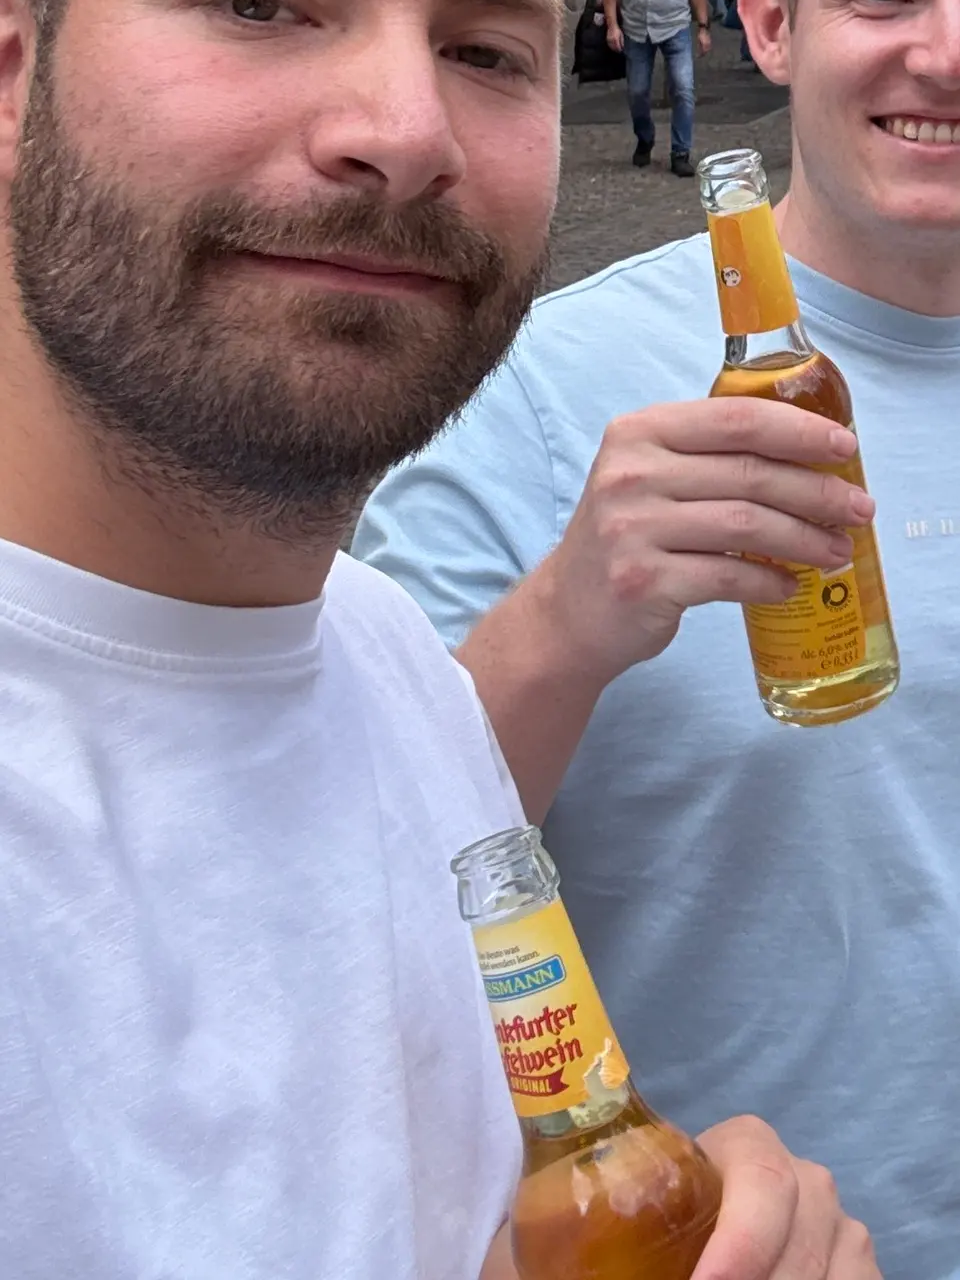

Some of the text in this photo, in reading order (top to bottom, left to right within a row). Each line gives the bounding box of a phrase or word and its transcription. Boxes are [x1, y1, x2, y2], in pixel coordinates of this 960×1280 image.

[905, 521, 931, 538] BE
[485, 965, 555, 996] SSMANN
[495, 1003, 577, 1044] nkfurter
[502, 1038, 583, 1074] felwein
